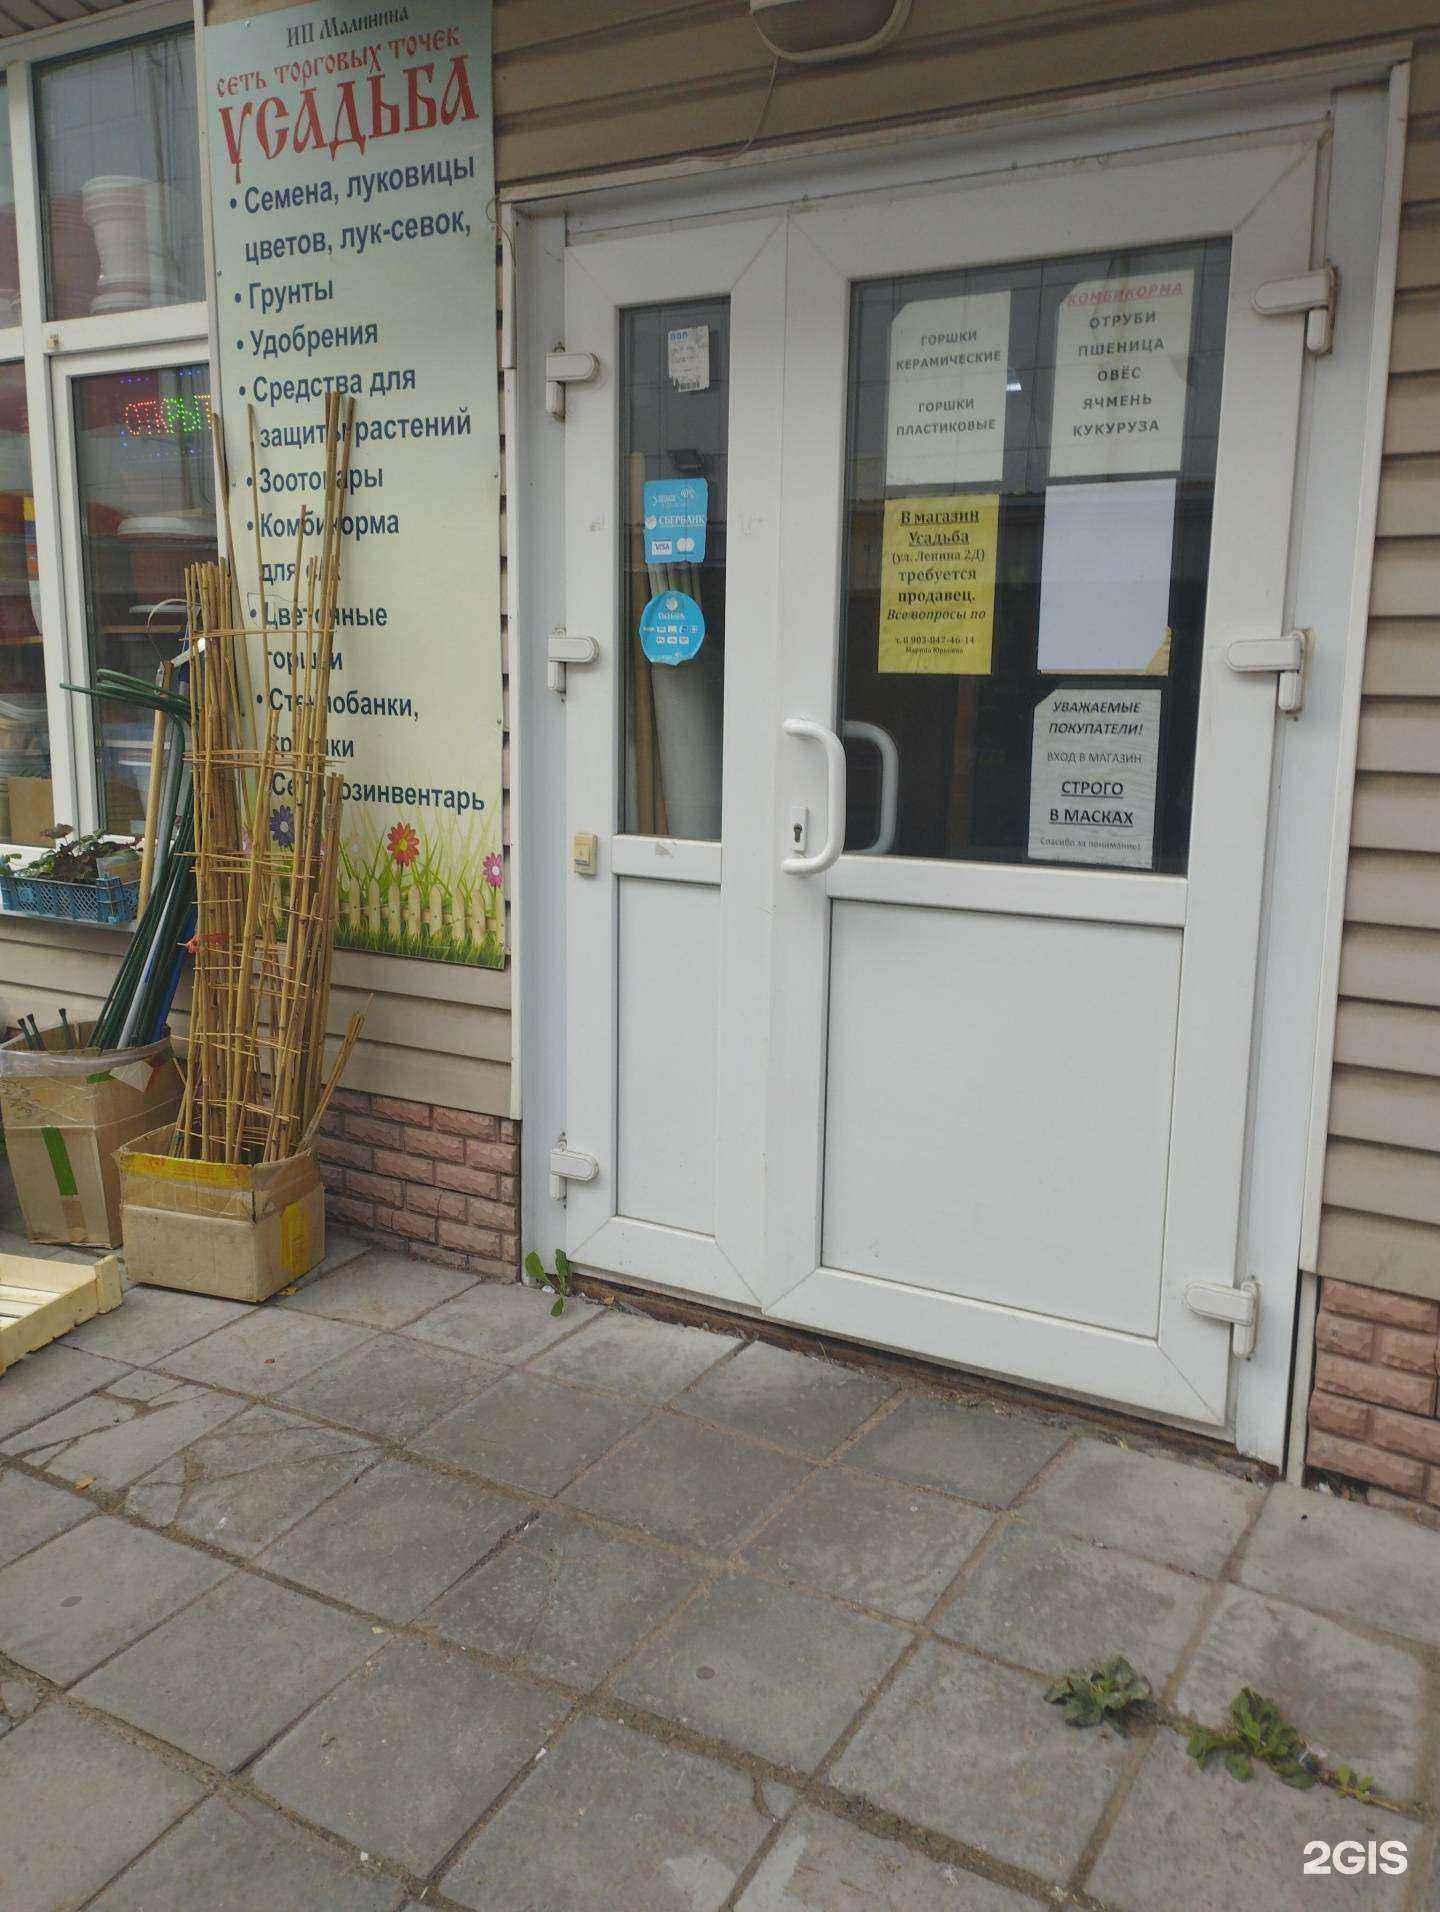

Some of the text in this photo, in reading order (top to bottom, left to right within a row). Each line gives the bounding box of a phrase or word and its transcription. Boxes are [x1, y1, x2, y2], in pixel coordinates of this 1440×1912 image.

[286, 6, 410, 48] ИП Малинина
[216, 26, 461, 98] сеть торговых точек
[218, 53, 480, 185] УСАДЬБА
[244, 156, 476, 214] Семена, луковицы
[245, 210, 471, 266] цветов, лук-севок,
[249, 280, 334, 314] Грунты
[1089, 311, 1156, 329] ОТРУБИ
[250, 322, 378, 360] Удобрения
[921, 330, 977, 346] ГОРШКИ
[1078, 337, 1165, 357] ПШЕНИЦА
[896, 350, 1001, 371] КЕРАМИЧЕСКИЕ
[1097, 365, 1142, 382] ОВЁС
[253, 369, 416, 408] Средства для
[918, 398, 974, 413] ГОРШКИ
[1083, 394, 1152, 410] ЯЧМЕНЬ
[355, 406, 471, 447] растений
[896, 419, 996, 437] ПЛАСТИКОВЫЕ
[1072, 419, 1159, 437] КУКУРУЗА
[259, 468, 383, 495] Зоотоары
[914, 510, 980, 525] магазин
[909, 530, 969, 545] Усадьба
[898, 568, 976, 585] требуется
[1053, 701, 1142, 715] УВАЖАЕМЫЕ
[1049, 722, 1143, 736] ПОКУПАТЕЛИ!
[1047, 751, 1076, 764] ВХОД
[1089, 752, 1141, 764] МАГАЗИН
[1061, 781, 1124, 796] СТРОГО
[1050, 808, 1134, 825] В МАСКАХ
